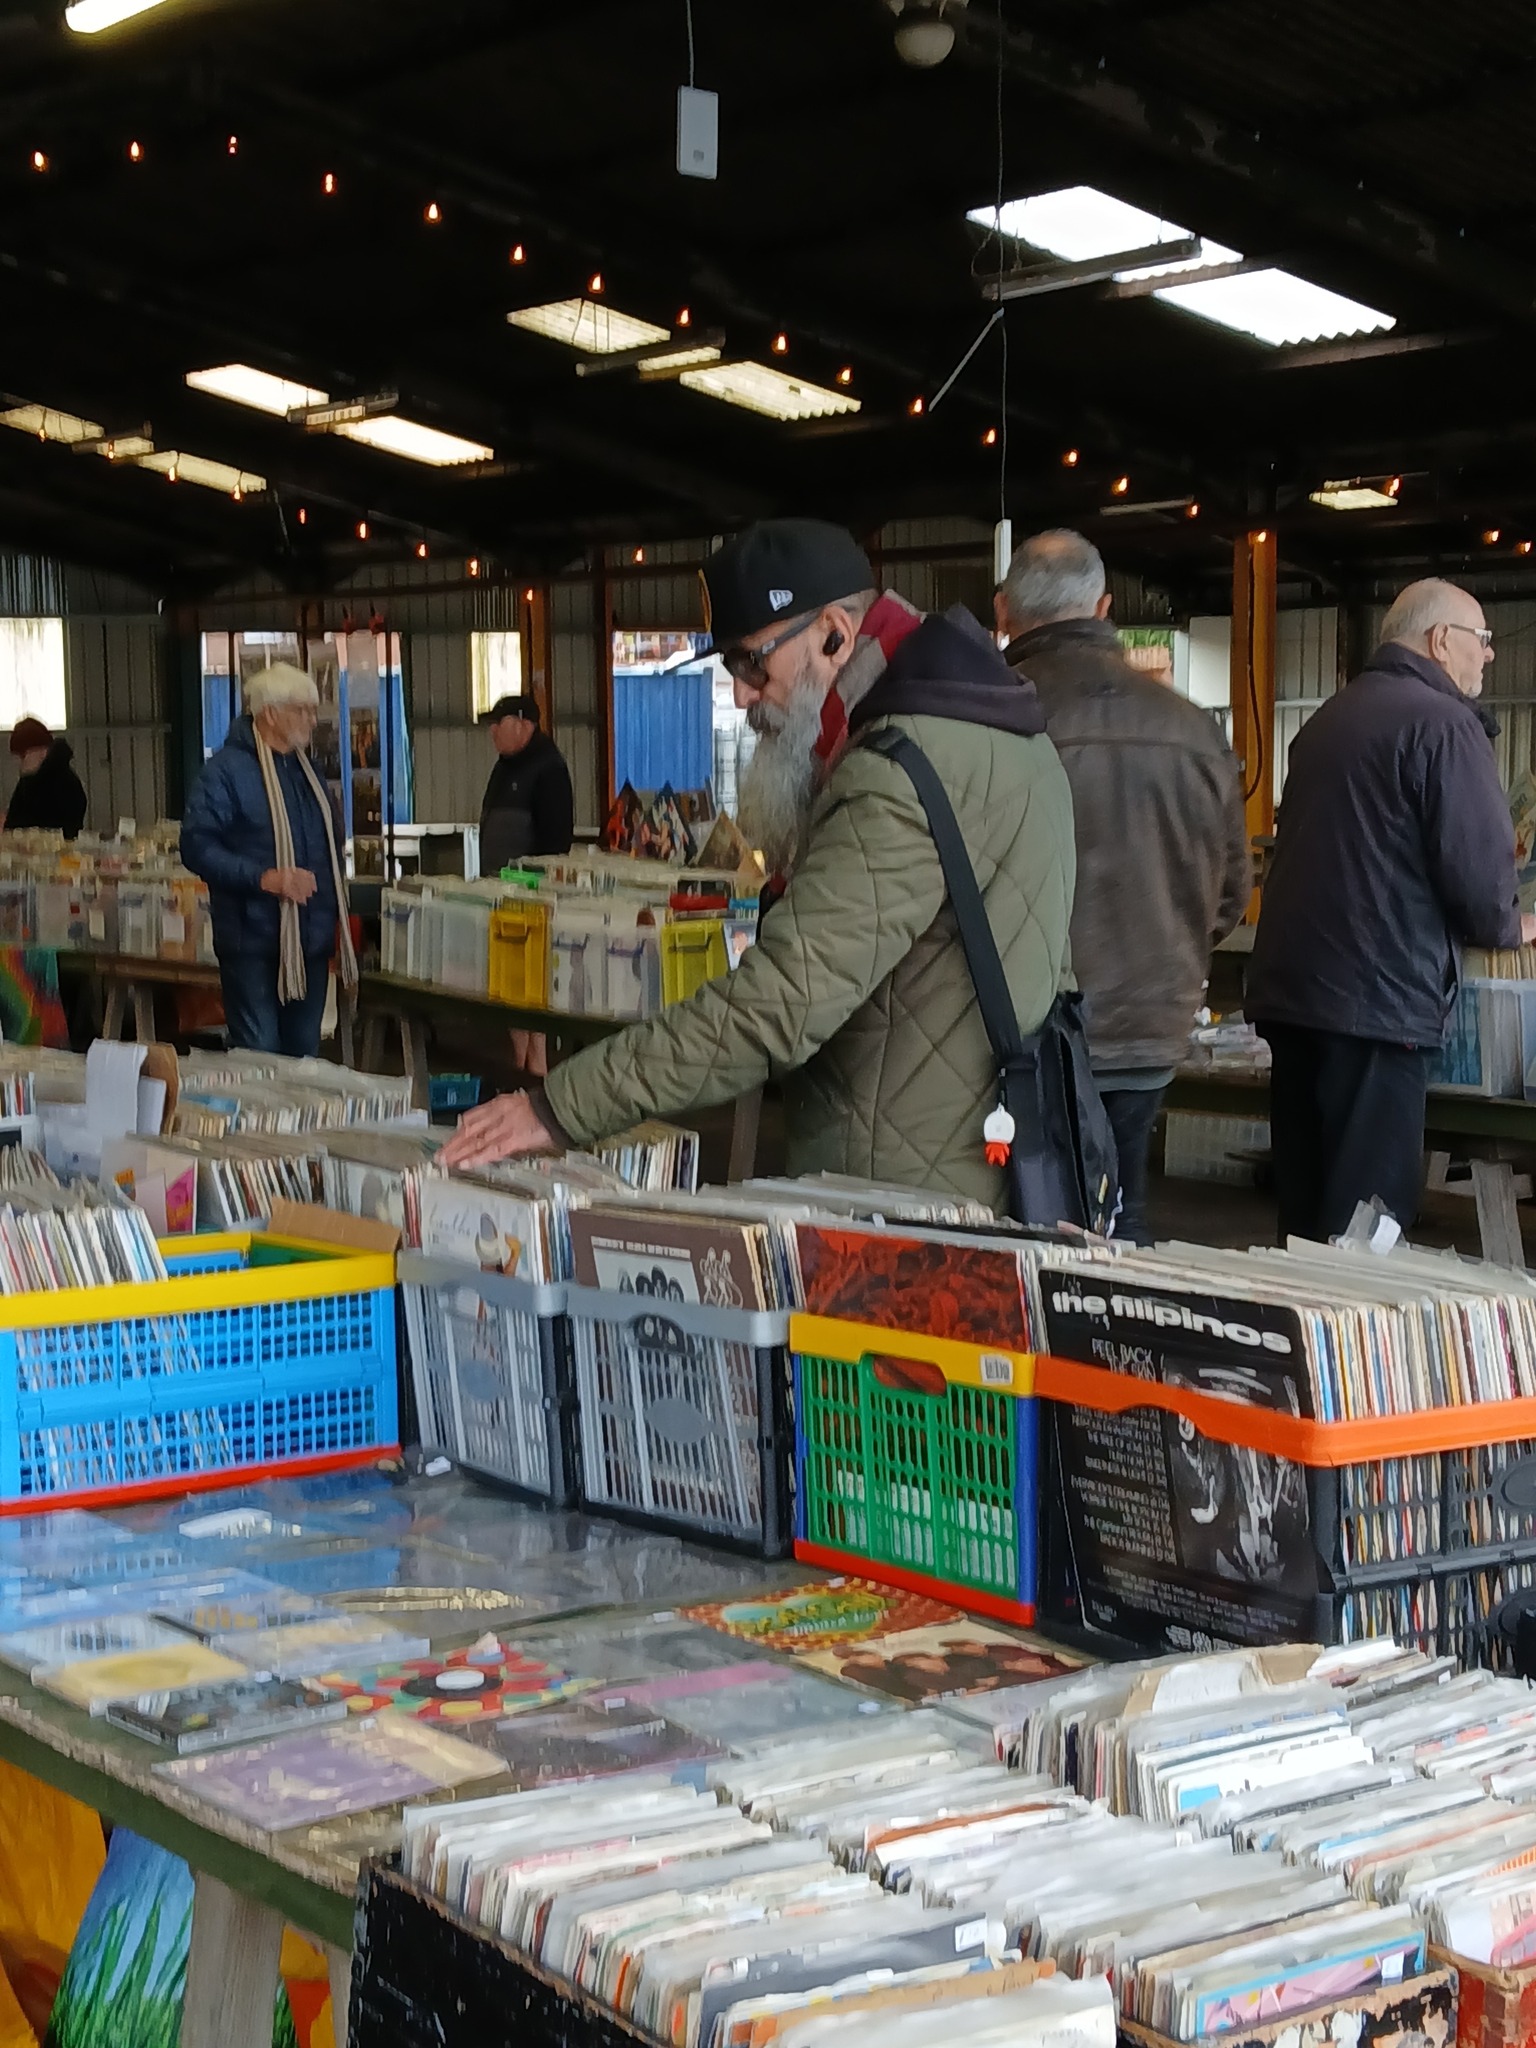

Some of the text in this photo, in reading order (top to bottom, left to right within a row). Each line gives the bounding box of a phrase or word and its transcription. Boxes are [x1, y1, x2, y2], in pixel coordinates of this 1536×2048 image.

[1052, 1291, 1292, 1354] the filipinos
[1119, 1342, 1152, 1364] BACK
